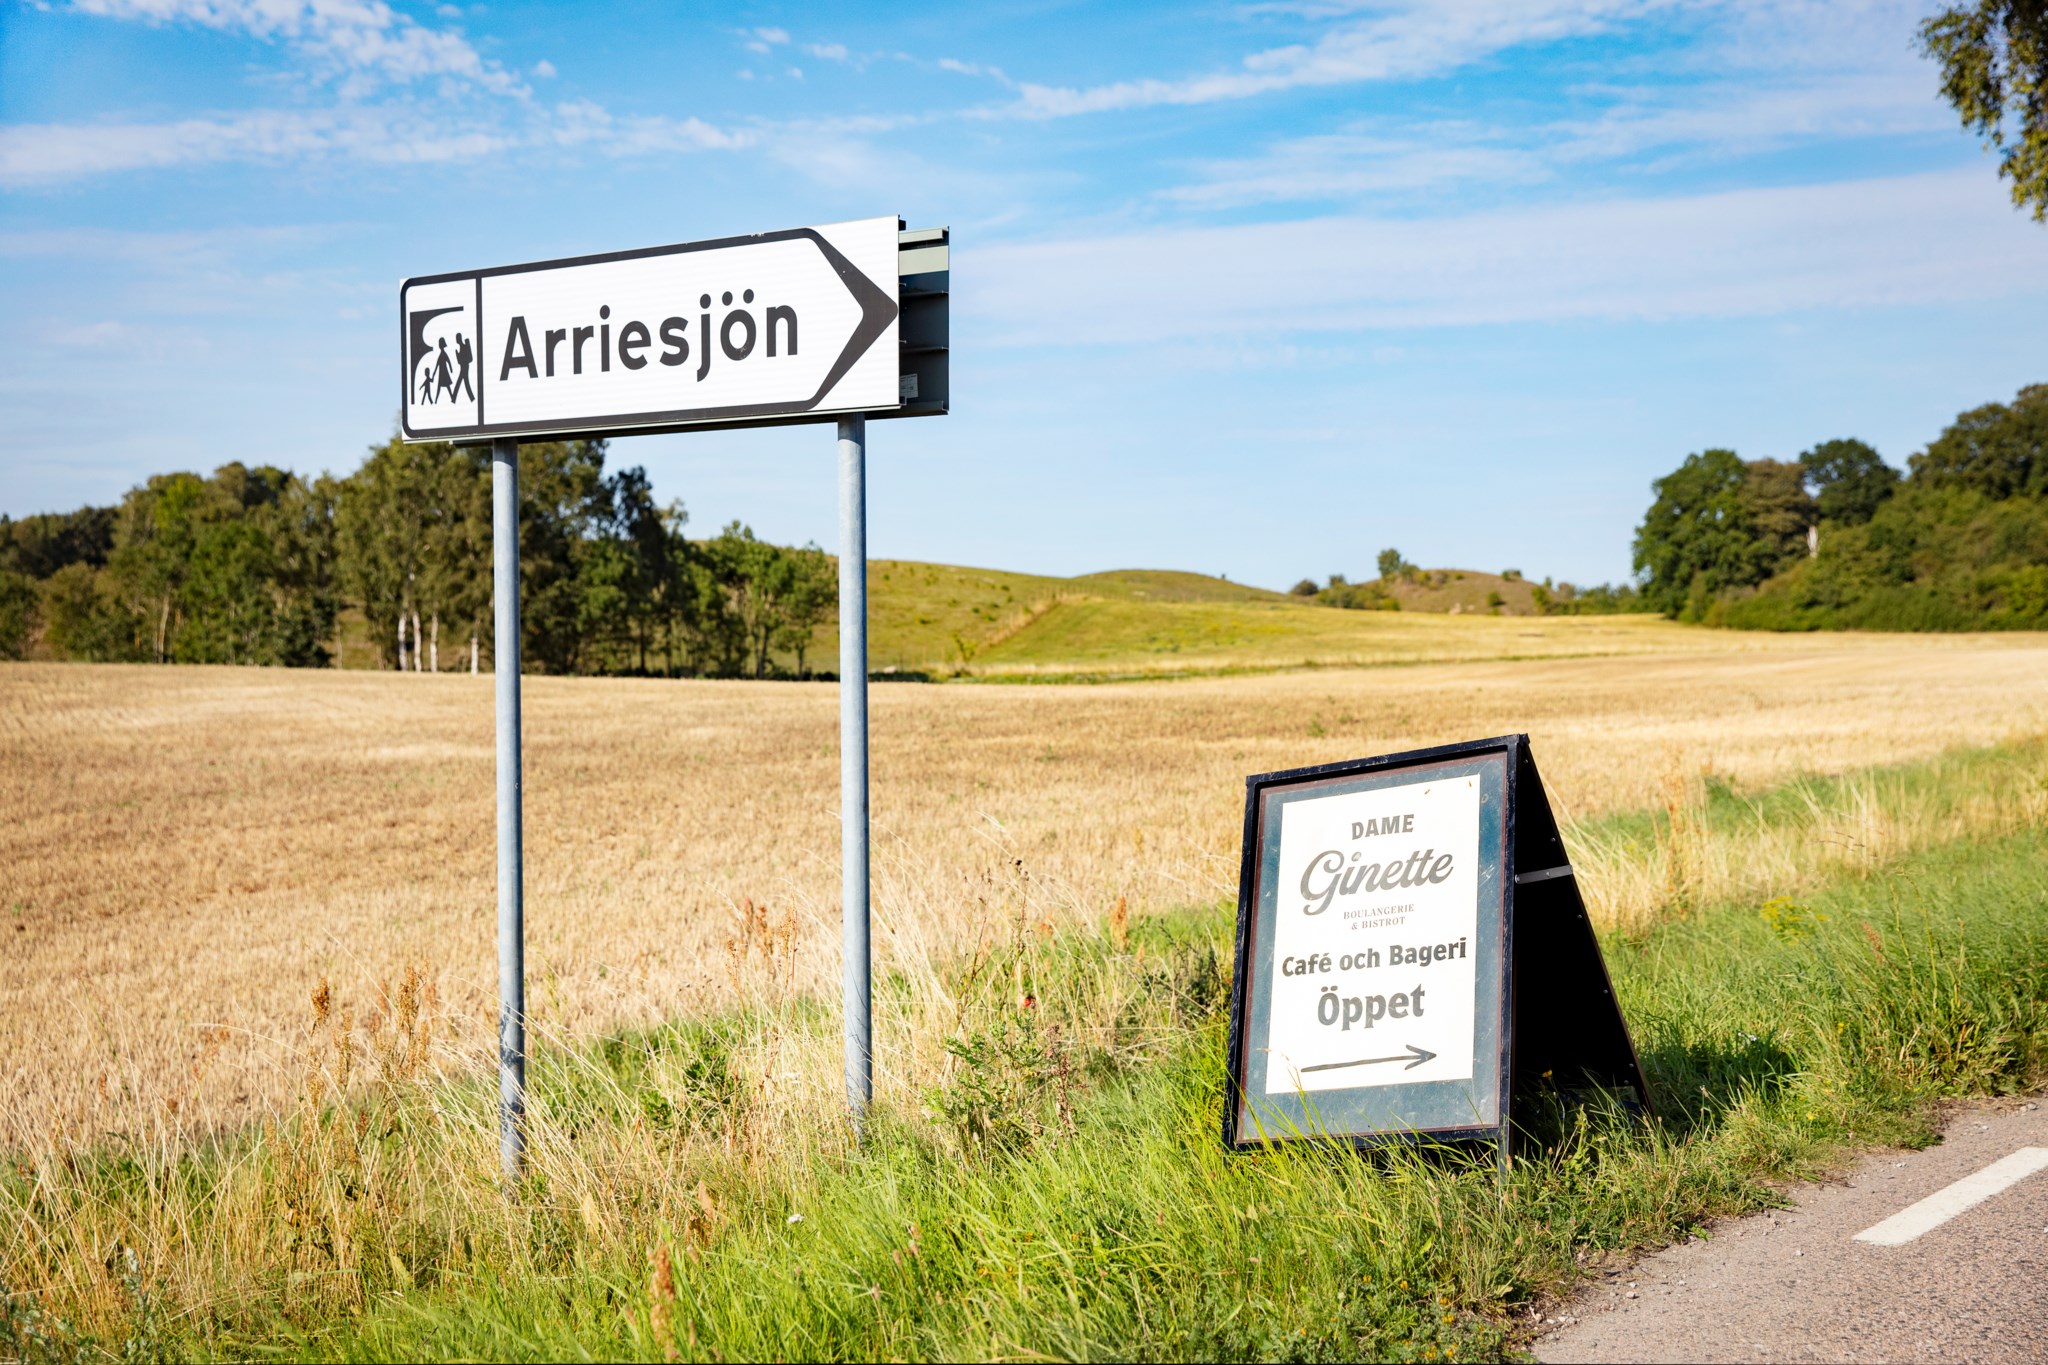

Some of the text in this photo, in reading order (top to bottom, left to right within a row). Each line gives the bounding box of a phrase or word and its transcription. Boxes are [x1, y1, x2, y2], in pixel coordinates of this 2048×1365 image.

[499, 288, 799, 383] Arriesjön
[1351, 813, 1415, 841] DAME
[1300, 849, 1454, 916] Ginette
[1343, 903, 1415, 920] BOULANGERIE
[1351, 916, 1406, 931] & BISTROT
[1282, 936, 1467, 977] Café och Bageri
[1317, 983, 1426, 1032] Öppet
